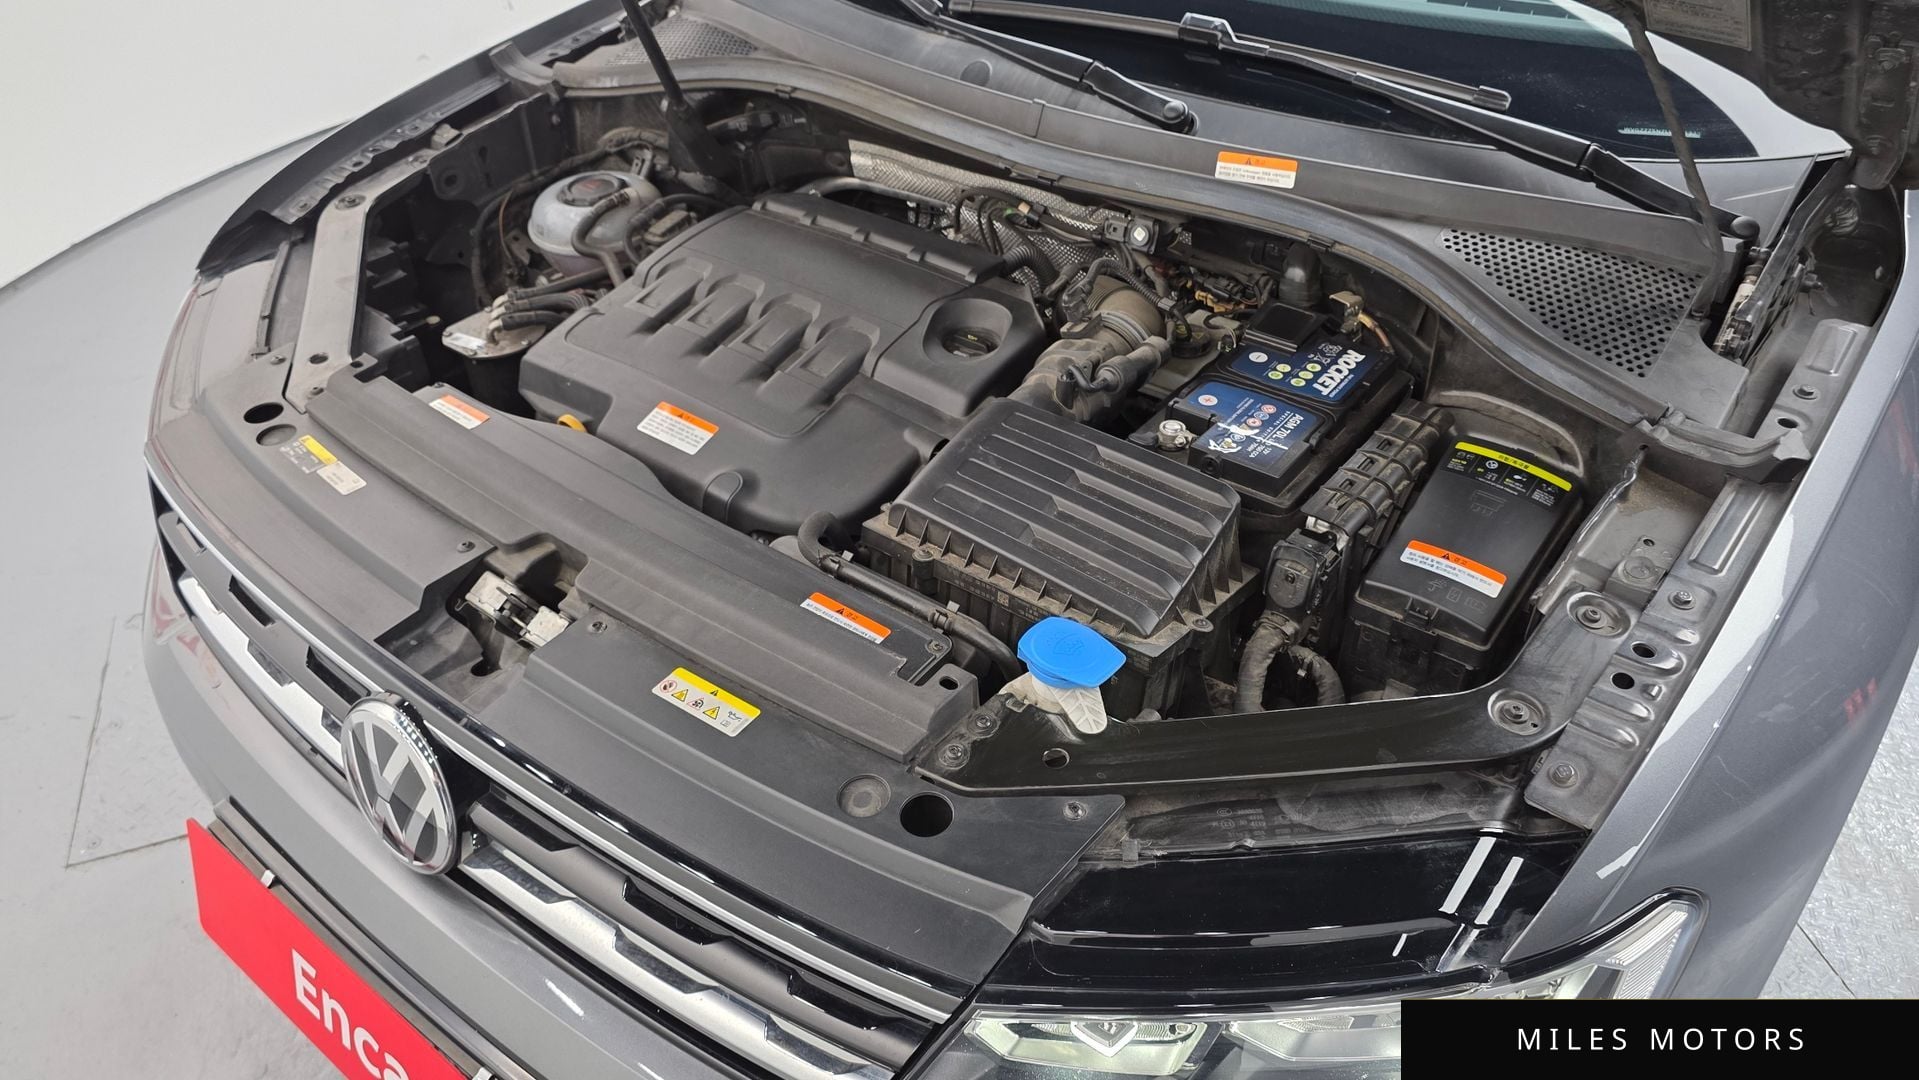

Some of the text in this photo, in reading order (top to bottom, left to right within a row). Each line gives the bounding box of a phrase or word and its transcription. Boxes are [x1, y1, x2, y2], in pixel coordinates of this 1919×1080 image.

[1312, 349, 1366, 396] ROCKET
[1272, 413, 1304, 439] AGM 70L
